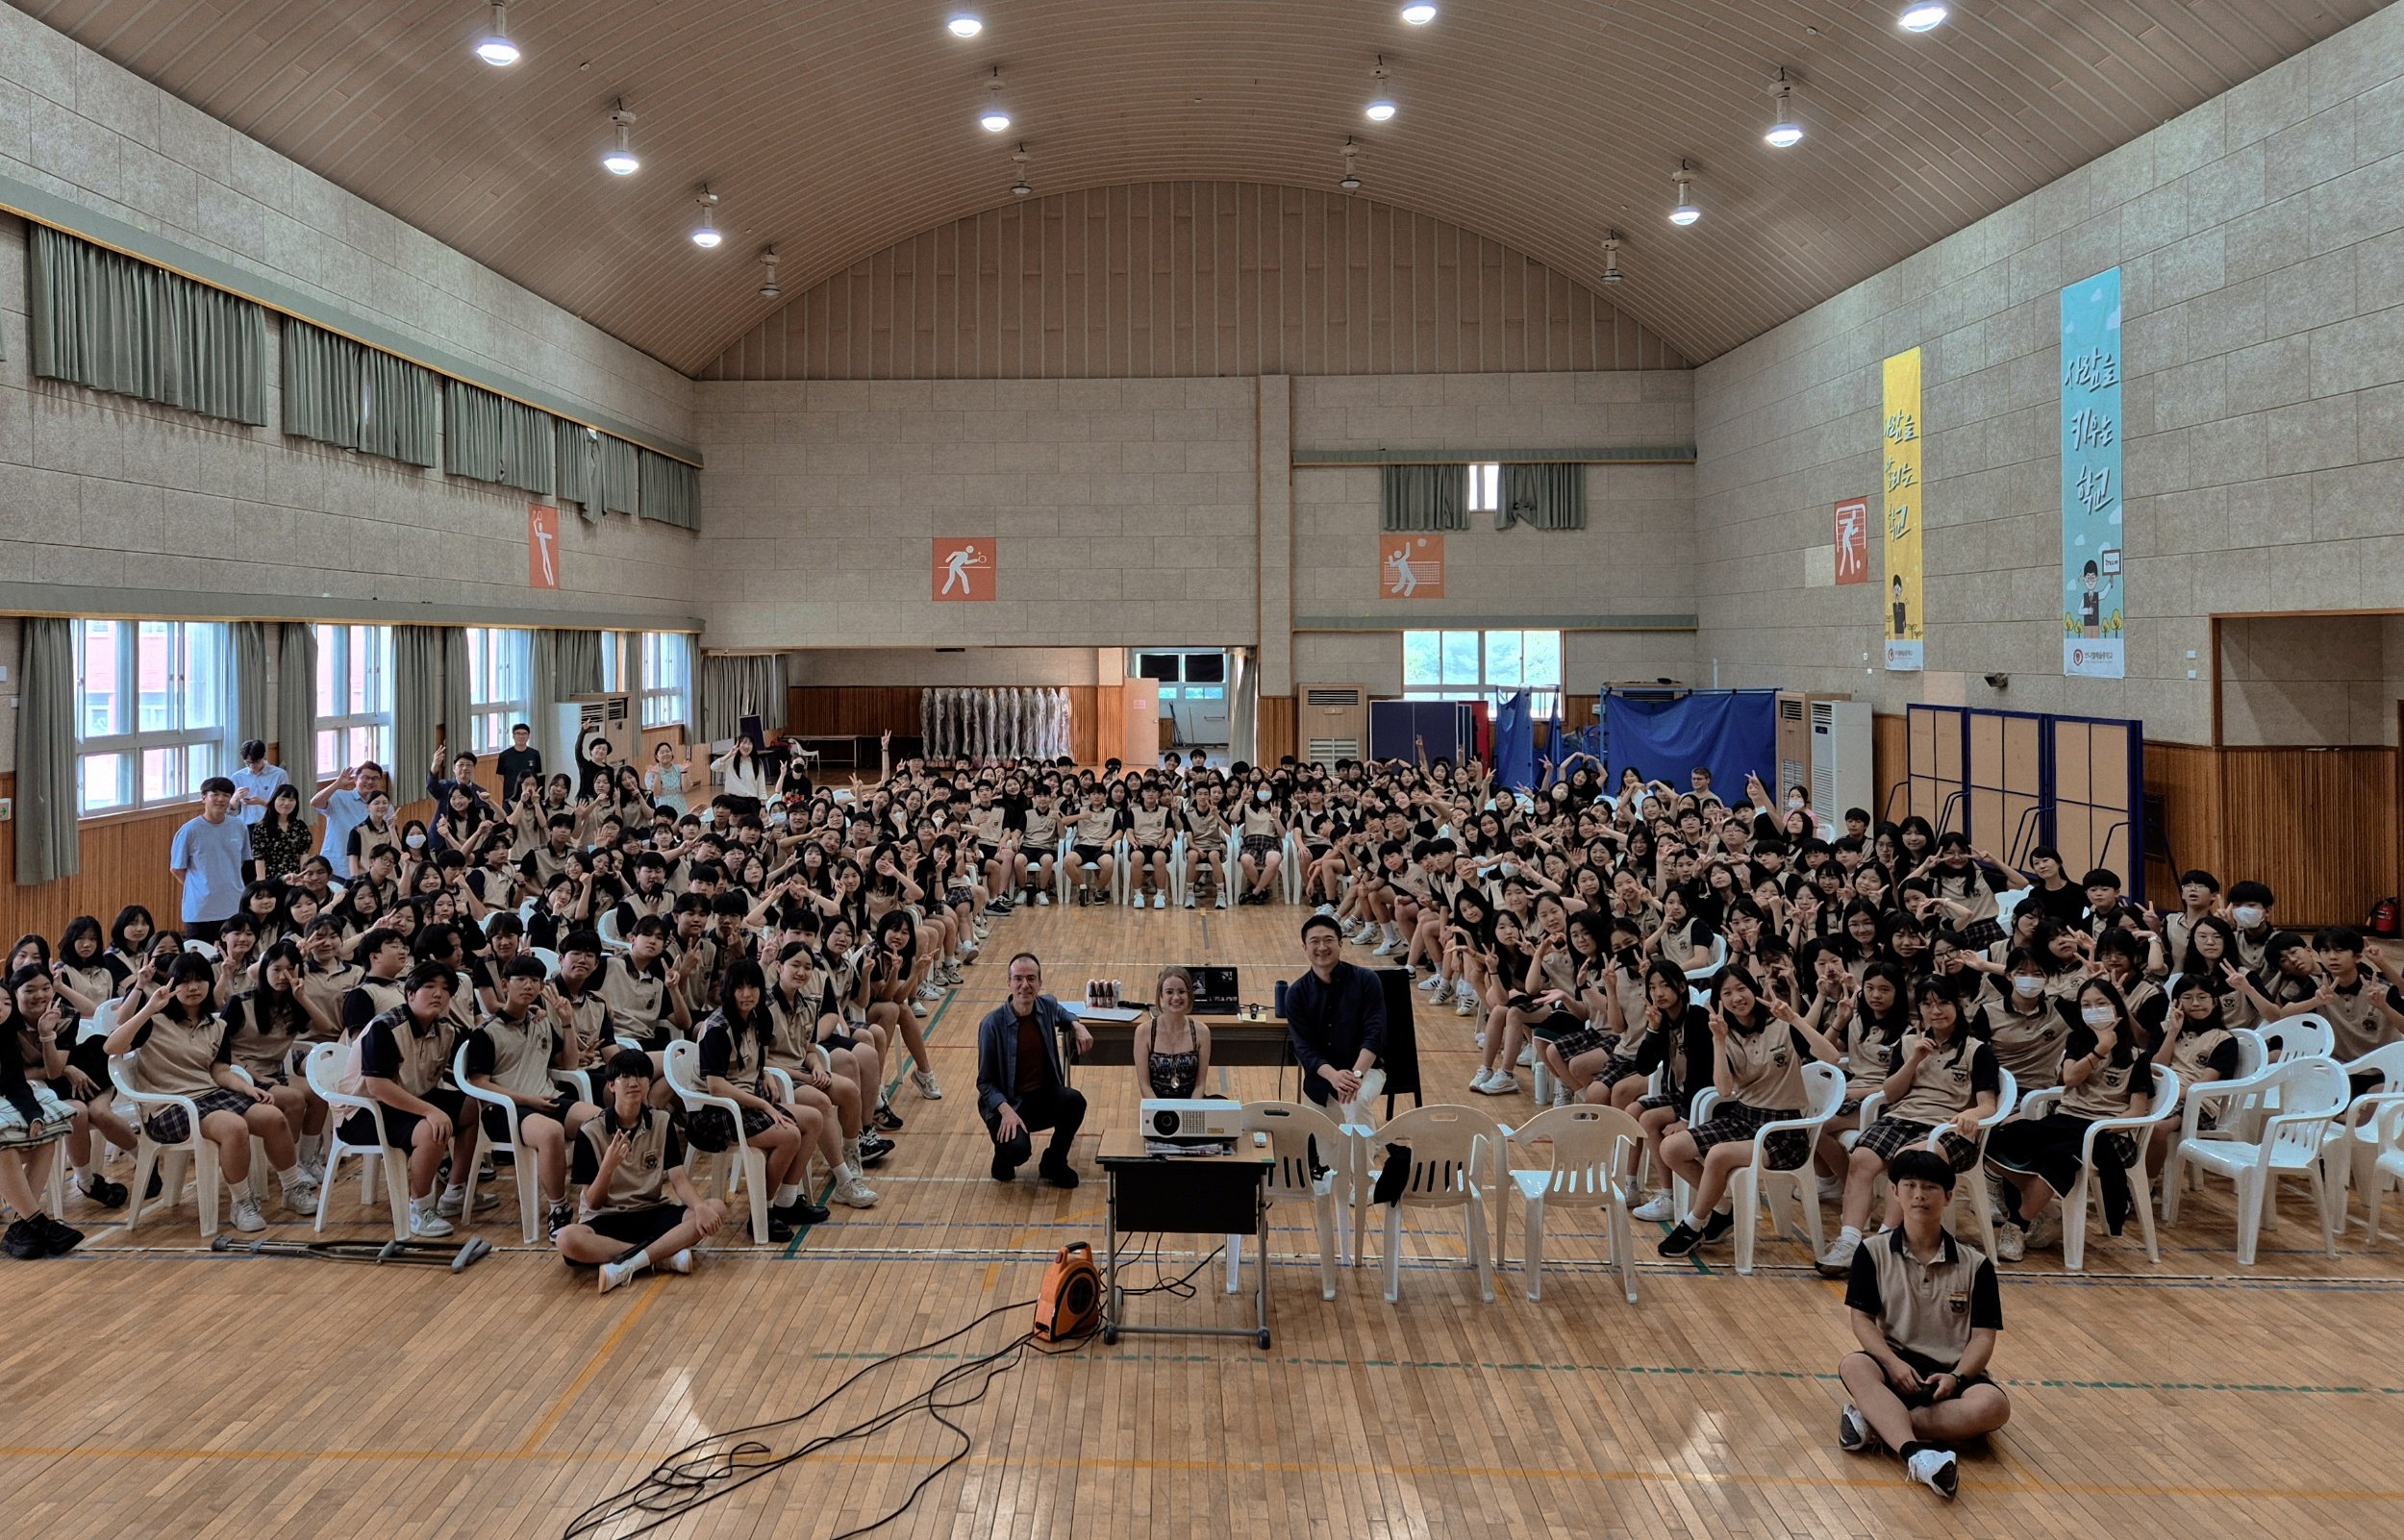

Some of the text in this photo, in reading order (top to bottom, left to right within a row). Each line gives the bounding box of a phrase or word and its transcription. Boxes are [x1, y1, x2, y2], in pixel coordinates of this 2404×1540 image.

[2064, 346, 2119, 393] 사람을
[2070, 407, 2114, 452] 키우는
[2075, 464, 2115, 516] 학교
[1888, 503, 1912, 543] 학교
